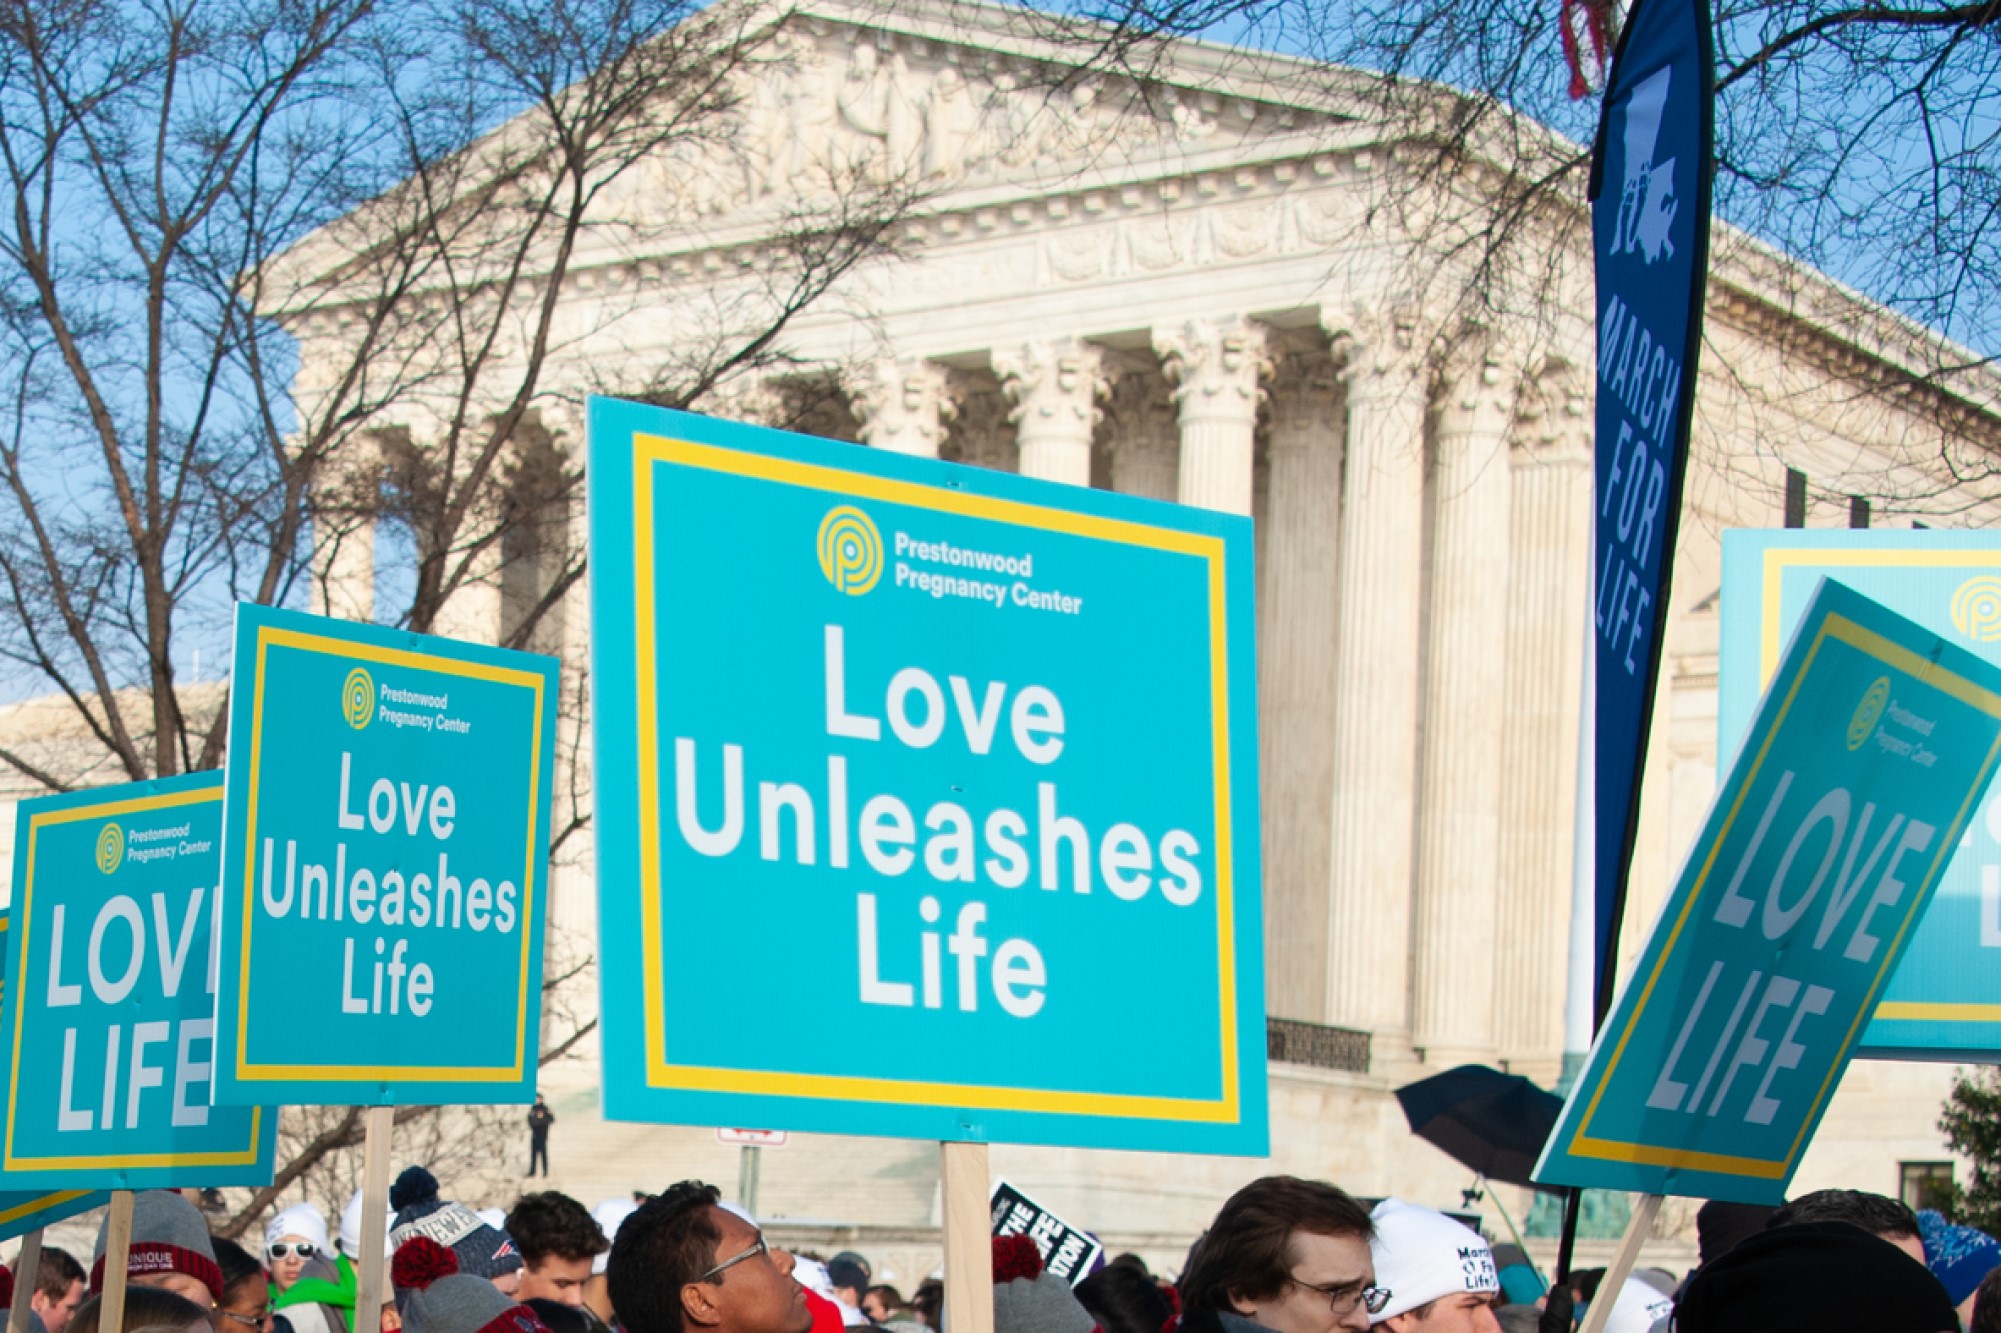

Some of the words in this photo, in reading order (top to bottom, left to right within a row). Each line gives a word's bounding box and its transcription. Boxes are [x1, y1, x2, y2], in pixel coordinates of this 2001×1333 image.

[1597, 293, 1681, 449] MARCH
[1603, 418, 1665, 569] FOR
[895, 531, 1033, 578] Prestonwood
[895, 561, 1007, 608] Pregnancy
[1011, 581, 1083, 615] Center
[1595, 543, 1651, 676] LIFE
[379, 704, 433, 732] Pregnancy
[435, 713, 471, 734] Center
[380, 683, 448, 709] Prestonwood
[824, 623, 1066, 764] Love
[127, 846, 177, 864] Pregnancy
[178, 840, 212, 856] Center
[128, 822, 190, 843] Prestonwood
[338, 751, 456, 840] Love
[674, 736, 1203, 906] Unleashes
[261, 837, 517, 933] Unleashes
[1714, 769, 1936, 963] LOVE
[47, 885, 220, 1008] LOV
[341, 937, 434, 1017] Life
[856, 892, 1048, 1018] Life
[58, 1017, 214, 1132] LIFE
[1646, 960, 1835, 1126] LIFE
